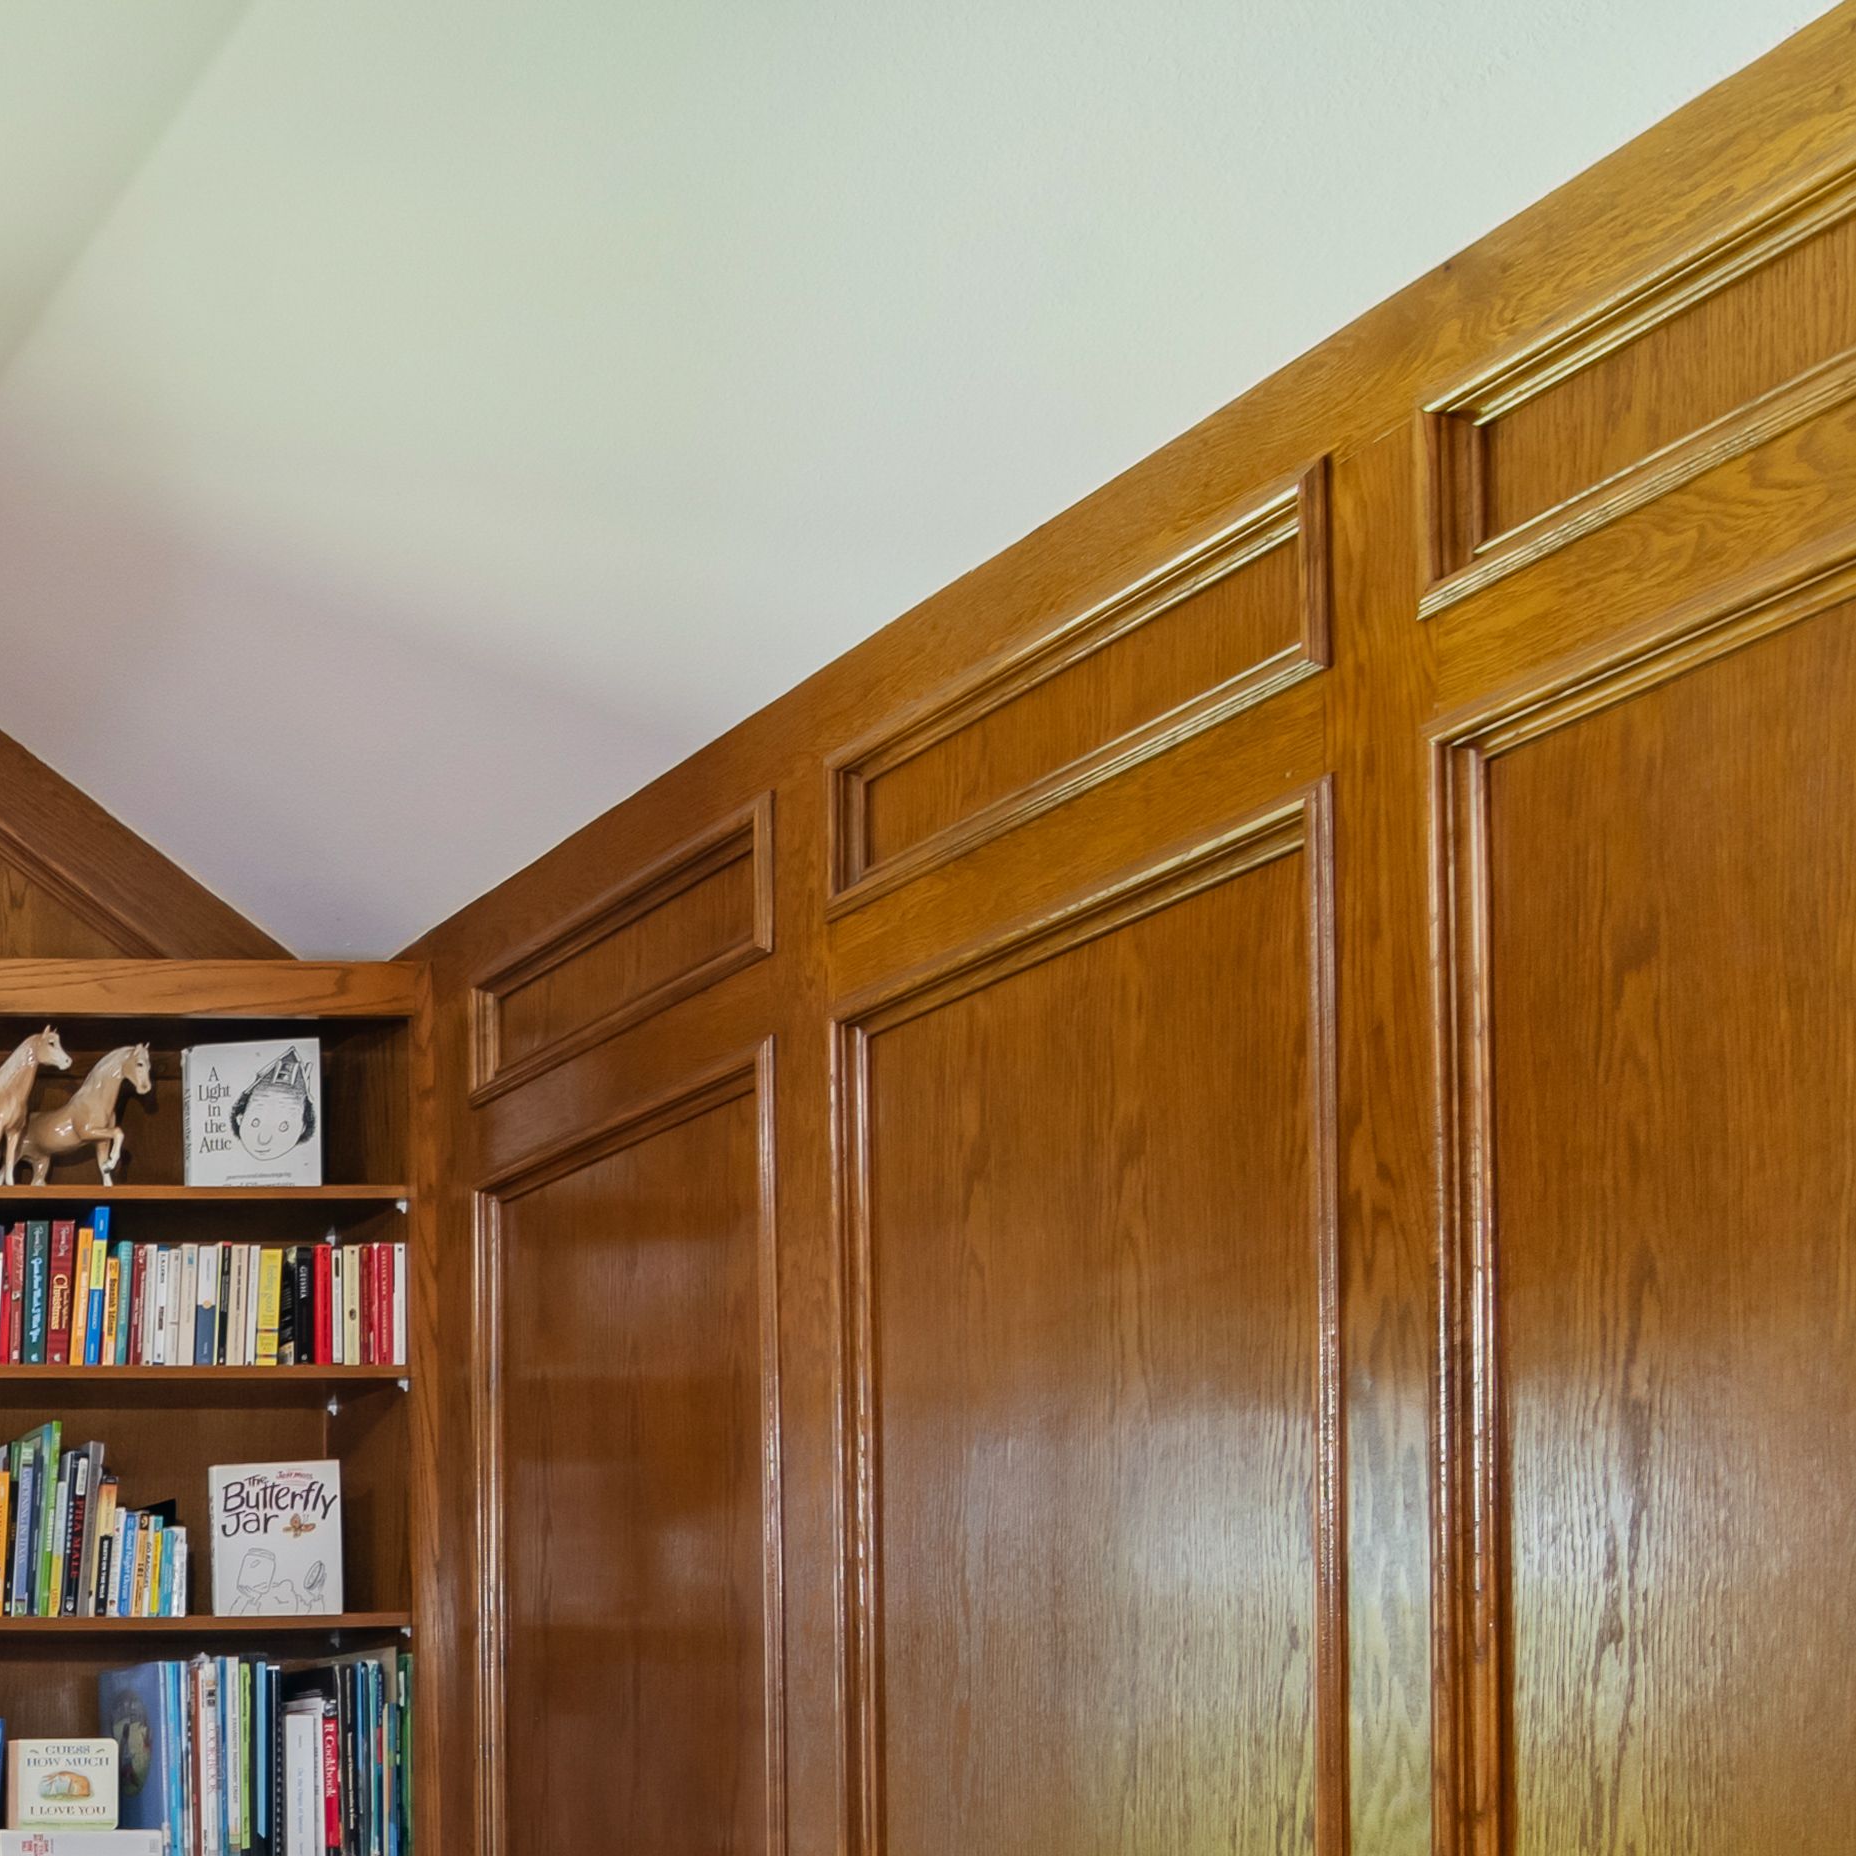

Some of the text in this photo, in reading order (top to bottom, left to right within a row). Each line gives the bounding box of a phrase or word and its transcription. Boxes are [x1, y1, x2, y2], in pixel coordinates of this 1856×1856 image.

[208, 1066, 219, 1082] A
[198, 1083, 231, 1103] Light
[208, 1104, 221, 1117] in
[204, 1120, 226, 1134] the
[199, 1137, 232, 1154] Attic
[51, 1274, 68, 1330] Christmas
[244, 1474, 268, 1487] The
[222, 1480, 338, 1519] Butterfly
[221, 1511, 279, 1537] Jar
[45, 1745, 91, 1755] GUESS
[27, 1757, 109, 1767] HOW MUCH
[325, 1723, 337, 1798] R Cookbook
[30, 1806, 106, 1815] I LOVE YOU
